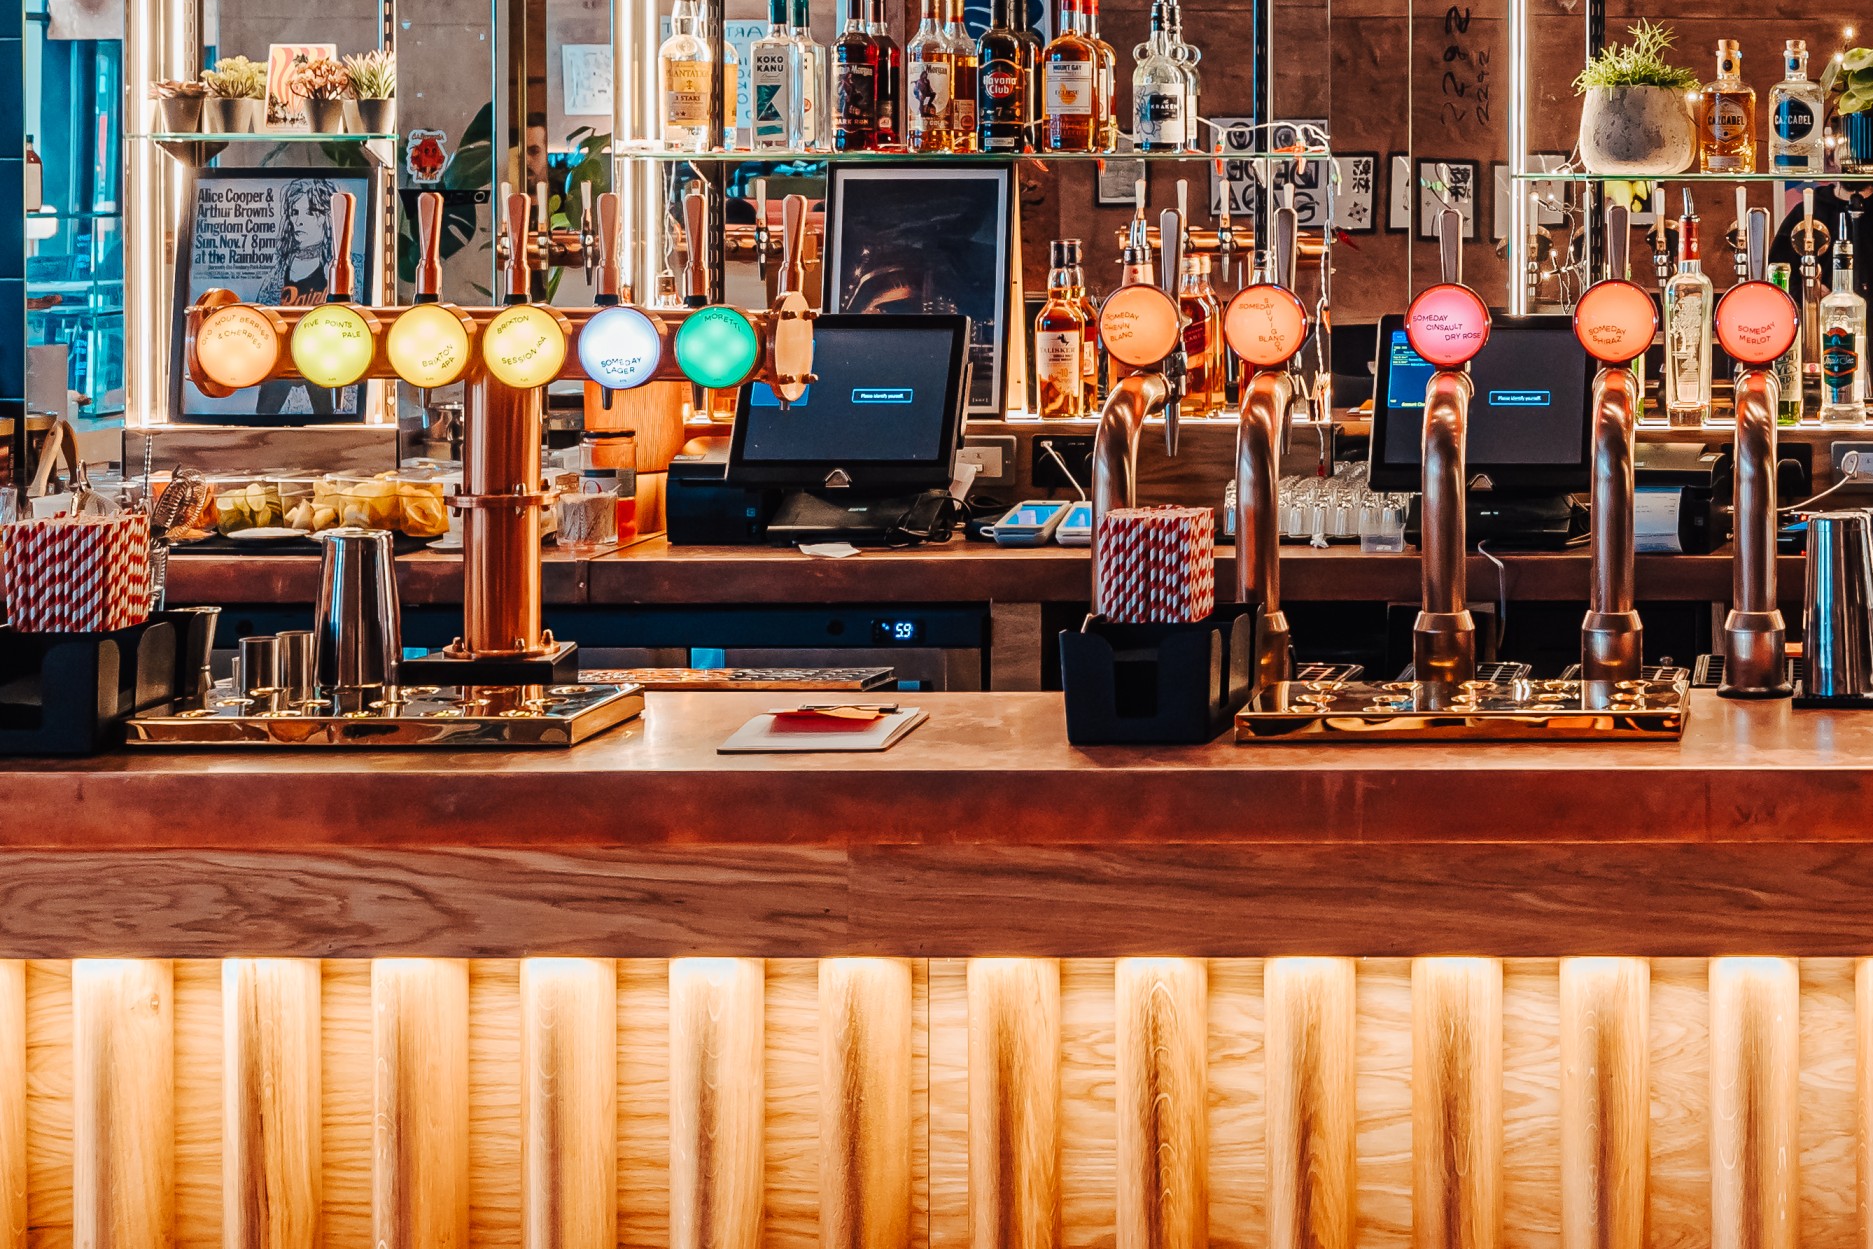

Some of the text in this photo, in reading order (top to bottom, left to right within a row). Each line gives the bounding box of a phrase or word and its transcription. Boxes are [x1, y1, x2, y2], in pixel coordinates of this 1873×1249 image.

[756, 55, 784, 64] KOKO
[756, 64, 784, 72] KANU
[926, 64, 948, 75] Morgan
[983, 74, 1017, 86] Havana
[988, 84, 1010, 94] Club
[1774, 114, 1812, 126] CAZCABEL
[198, 188, 274, 206] Alice Cooper &
[197, 203, 274, 218] Arthur Brown's
[196, 219, 276, 236] Kingdom Come
[195, 234, 218, 249] Sun.
[195, 249, 274, 264] at the Rainbow
[1105, 311, 1140, 321] SOMEDAY
[1412, 314, 1448, 322] SOMEDAY
[303, 318, 353, 329] FIVE POINTS
[496, 314, 530, 335] BRIXTON
[704, 313, 742, 332] MORETTI
[1104, 323, 1130, 331] CHENIN
[1426, 323, 1463, 331] CINSAULT
[1738, 321, 1776, 333] SOMEDAY
[239, 317, 270, 341] BERRIES
[1588, 325, 1627, 336] SOMEDAY
[224, 329, 262, 350] CHERRIES
[342, 331, 361, 339] PALE
[1110, 331, 1134, 342] BLANC
[1258, 334, 1285, 342] BLANC
[1445, 332, 1461, 341] DRY
[1592, 335, 1622, 344] SHIRAZ
[1739, 334, 1772, 345] MERLOT
[1040, 346, 1076, 354] TALISKER
[422, 344, 453, 368] BRIXTON
[501, 347, 537, 366] SESSION
[601, 357, 642, 368] SOMEDAY
[606, 366, 636, 374] LAGER
